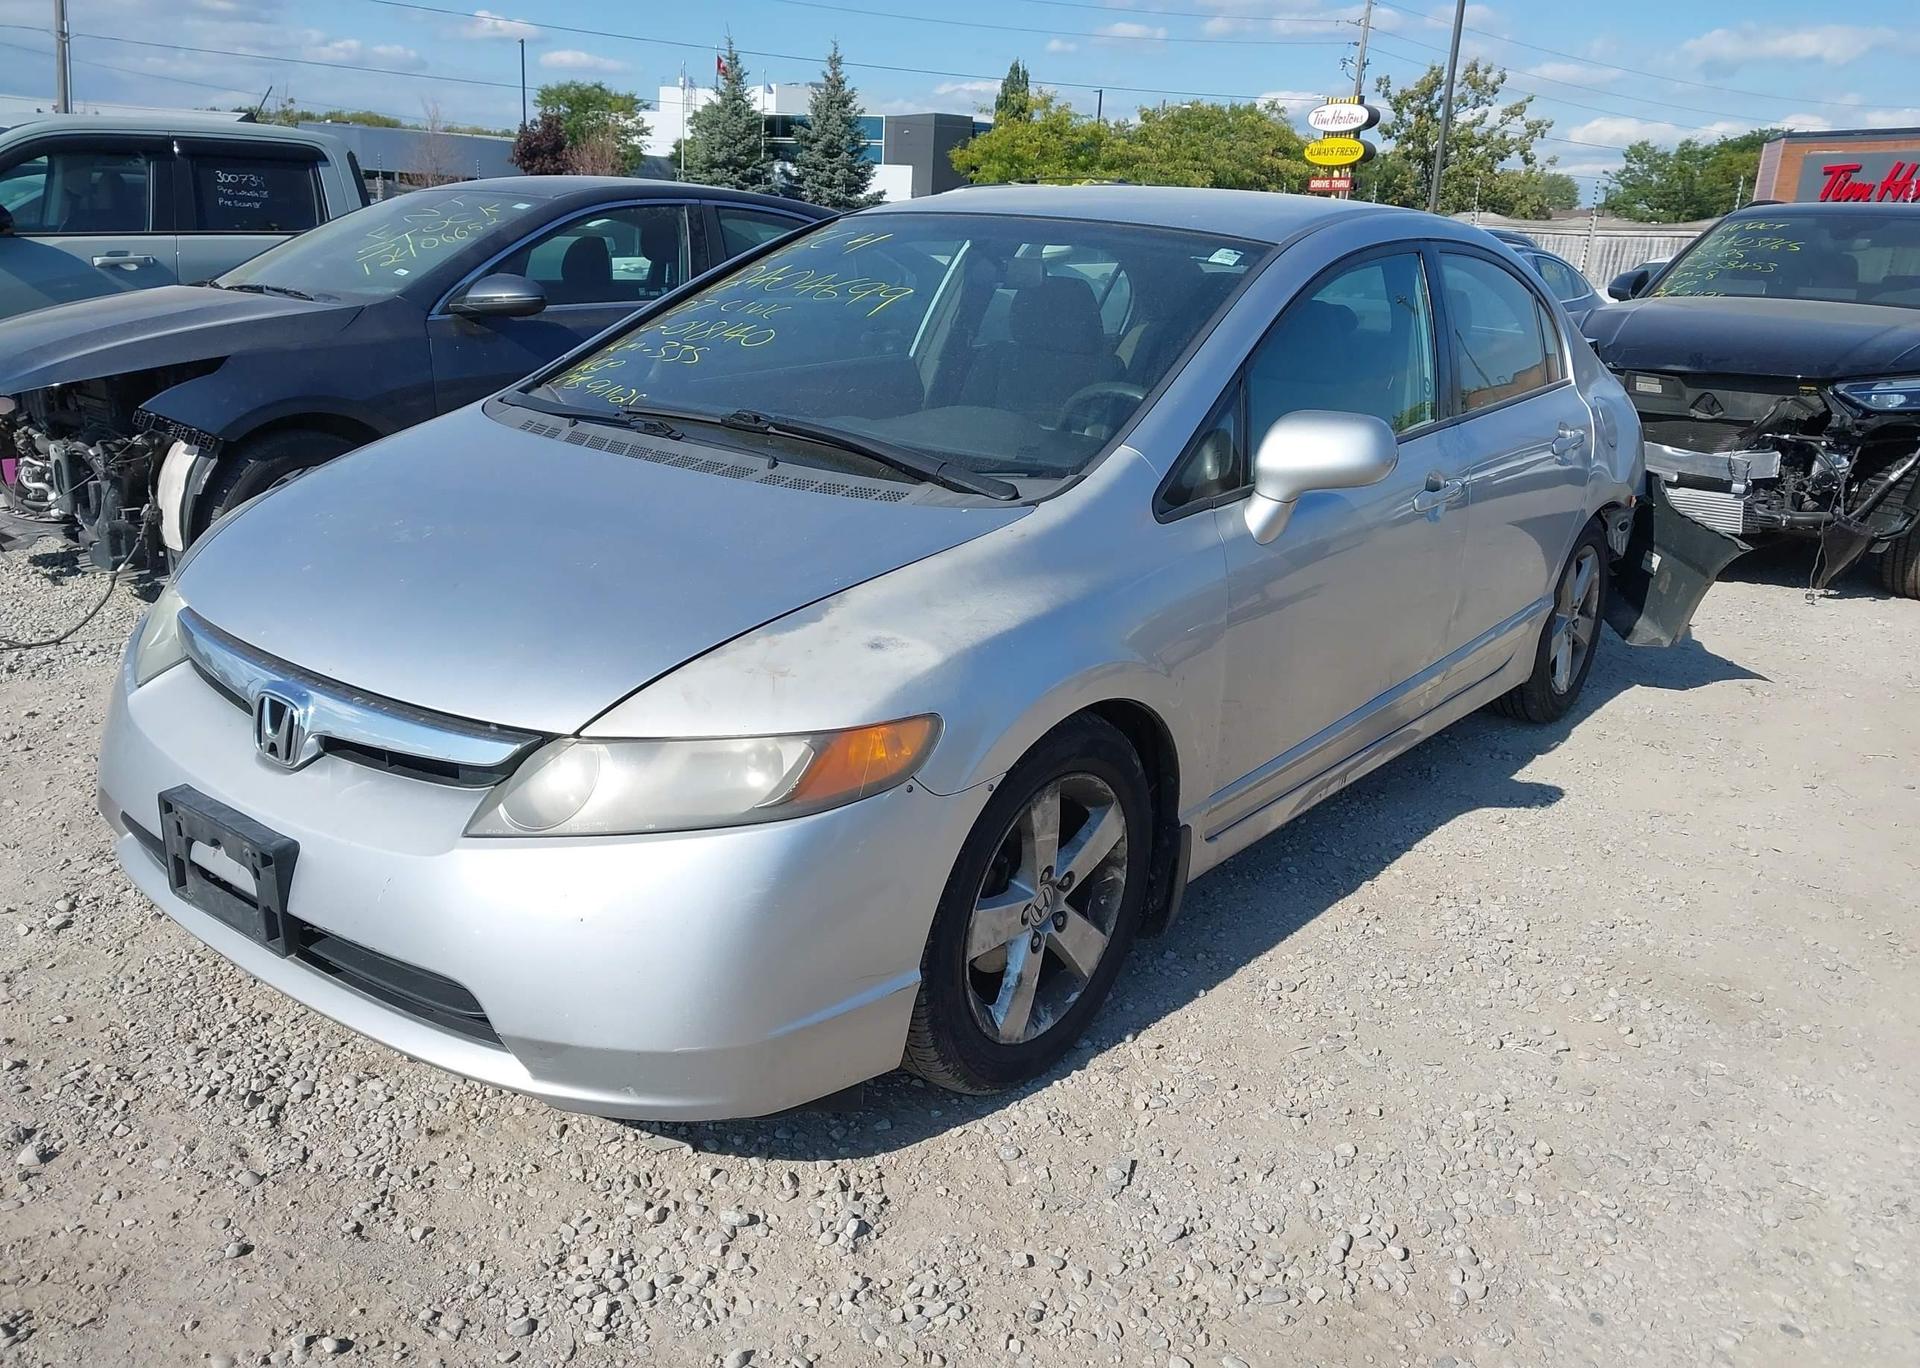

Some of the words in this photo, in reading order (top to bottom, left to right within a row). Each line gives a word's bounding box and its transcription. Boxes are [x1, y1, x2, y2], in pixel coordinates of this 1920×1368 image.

[1331, 109, 1364, 125] Hortons
[1309, 147, 1335, 157] ALWAYS
[1335, 146, 1360, 157] FRESH
[215, 170, 265, 188] 300734
[1310, 179, 1330, 188] DRIVE
[1331, 179, 1350, 188] THRU
[1819, 164, 1875, 202] Tim
